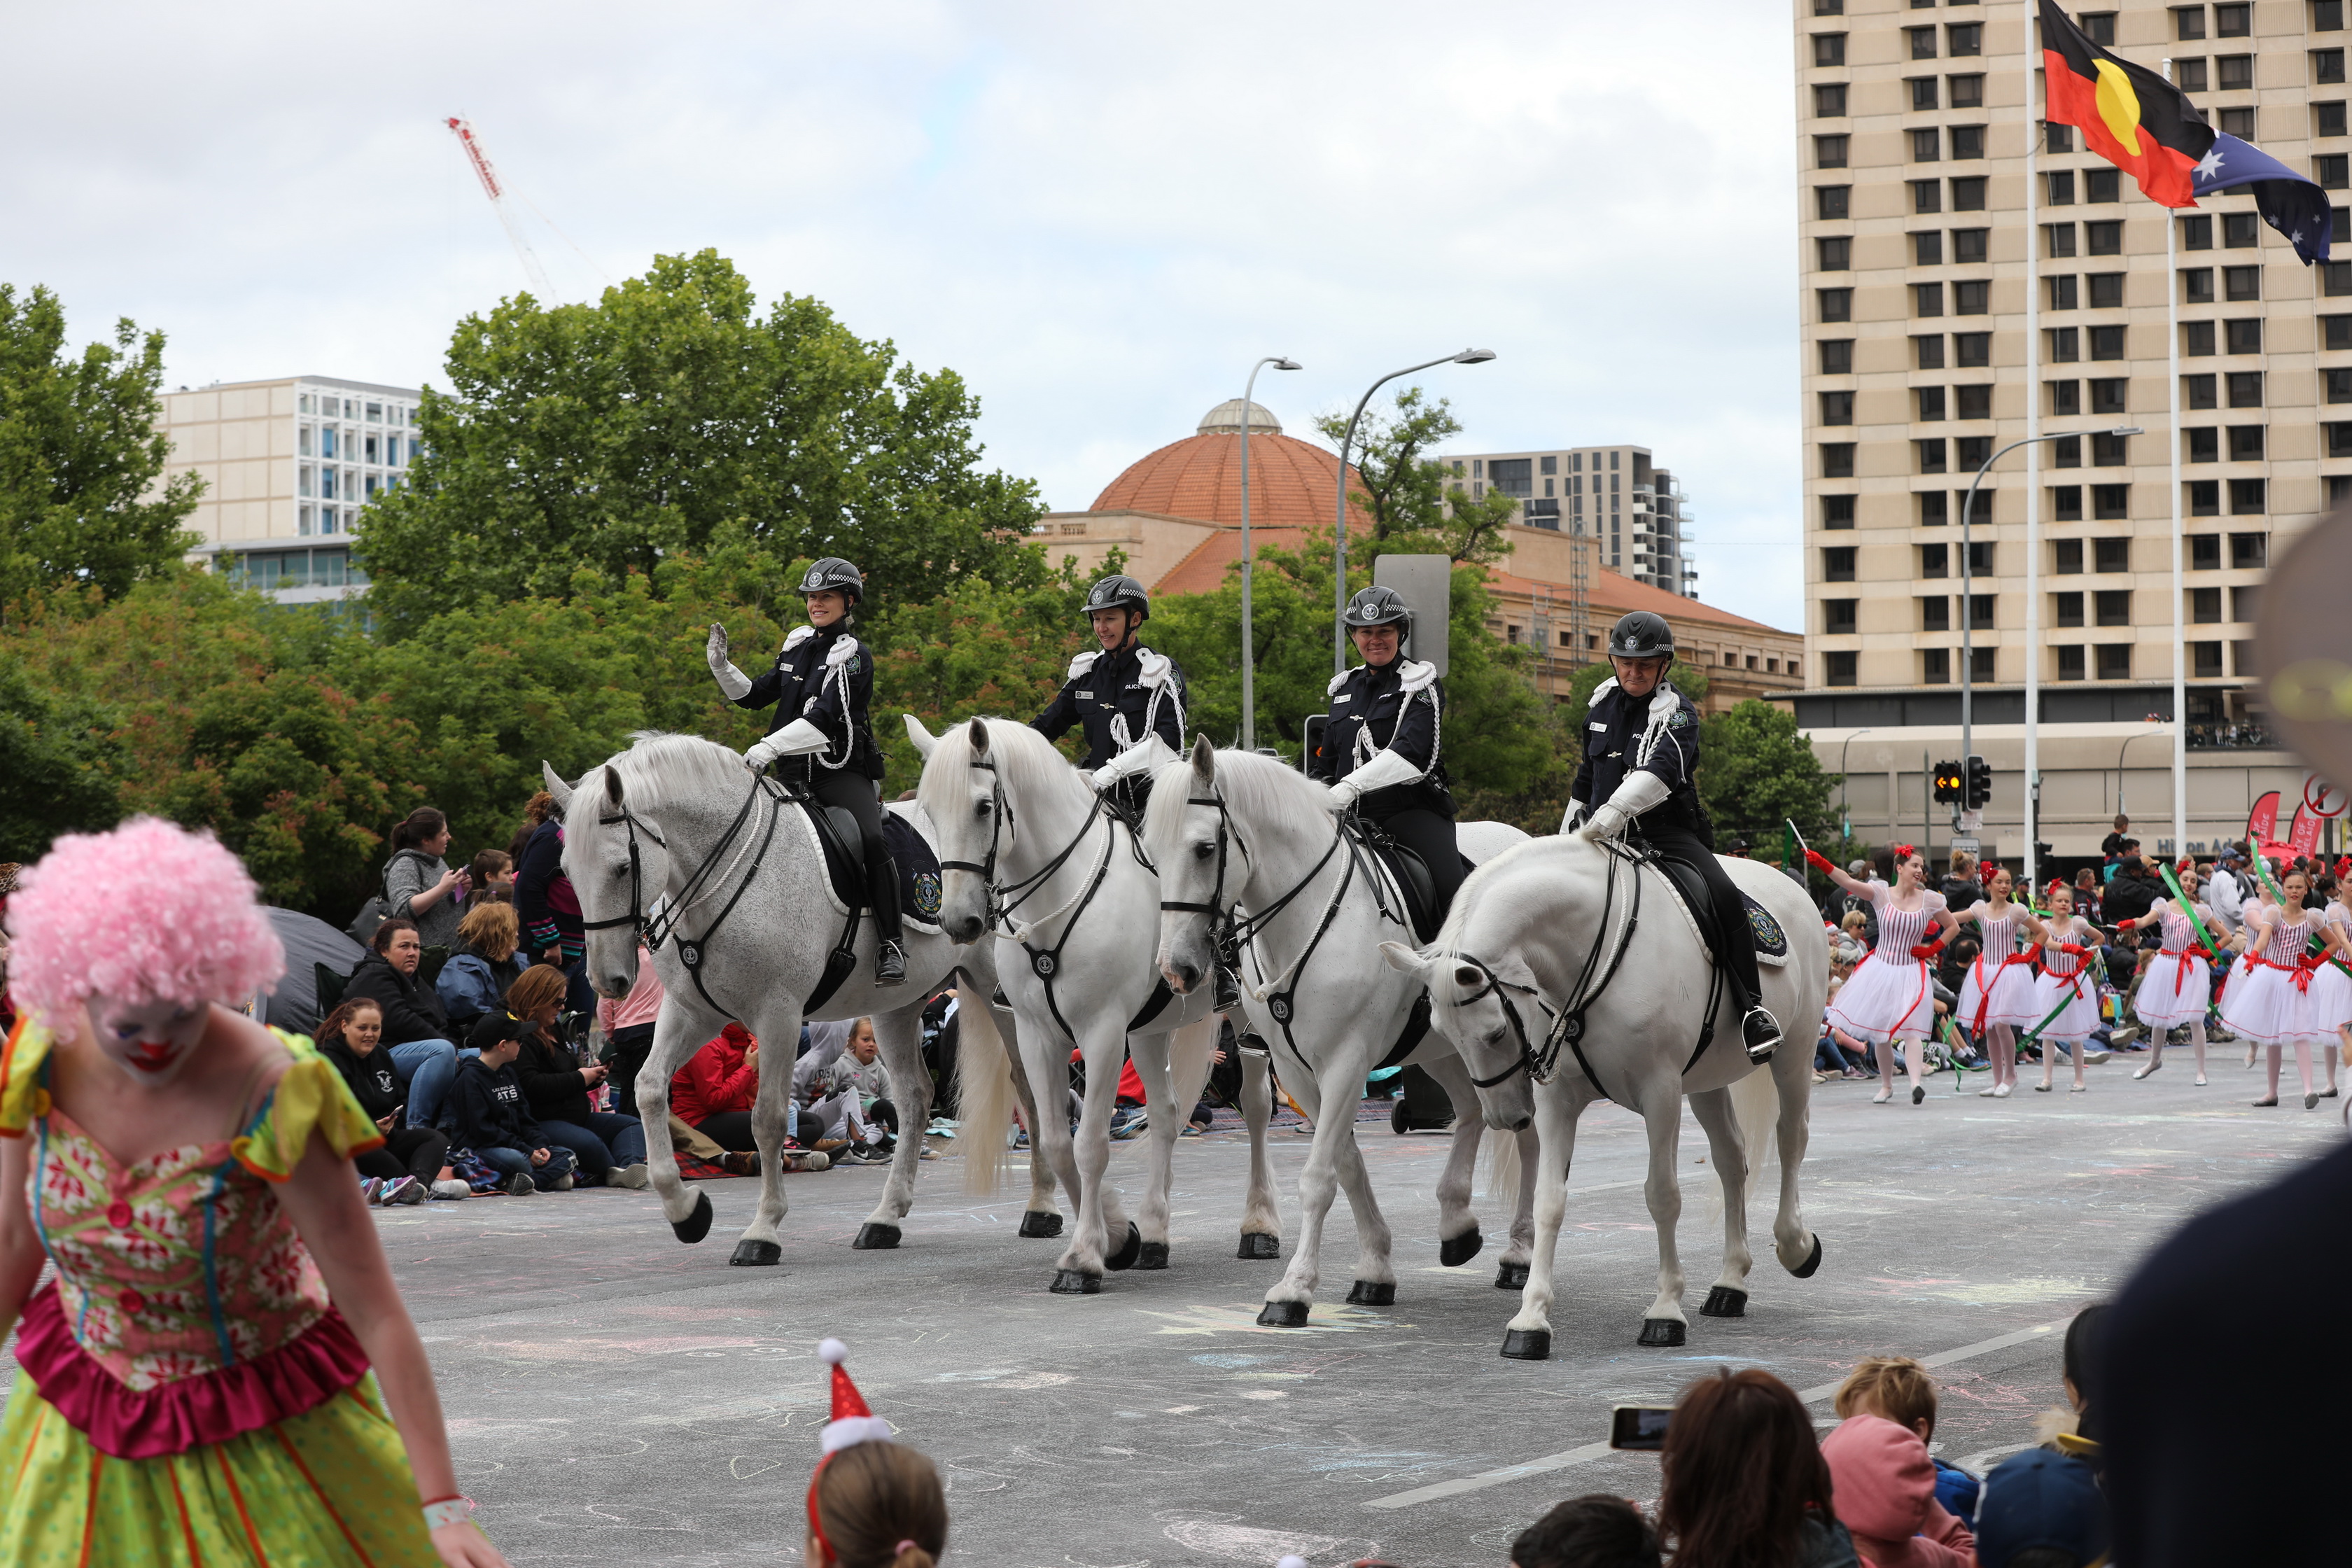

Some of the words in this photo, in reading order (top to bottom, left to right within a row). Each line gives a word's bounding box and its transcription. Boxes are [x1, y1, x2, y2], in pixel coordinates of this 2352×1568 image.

[2258, 813, 2270, 847] ELAIDE
[2302, 817, 2316, 855] DELAID
[2157, 838, 2206, 853] Hion
[498, 1088, 518, 1100] ATS
